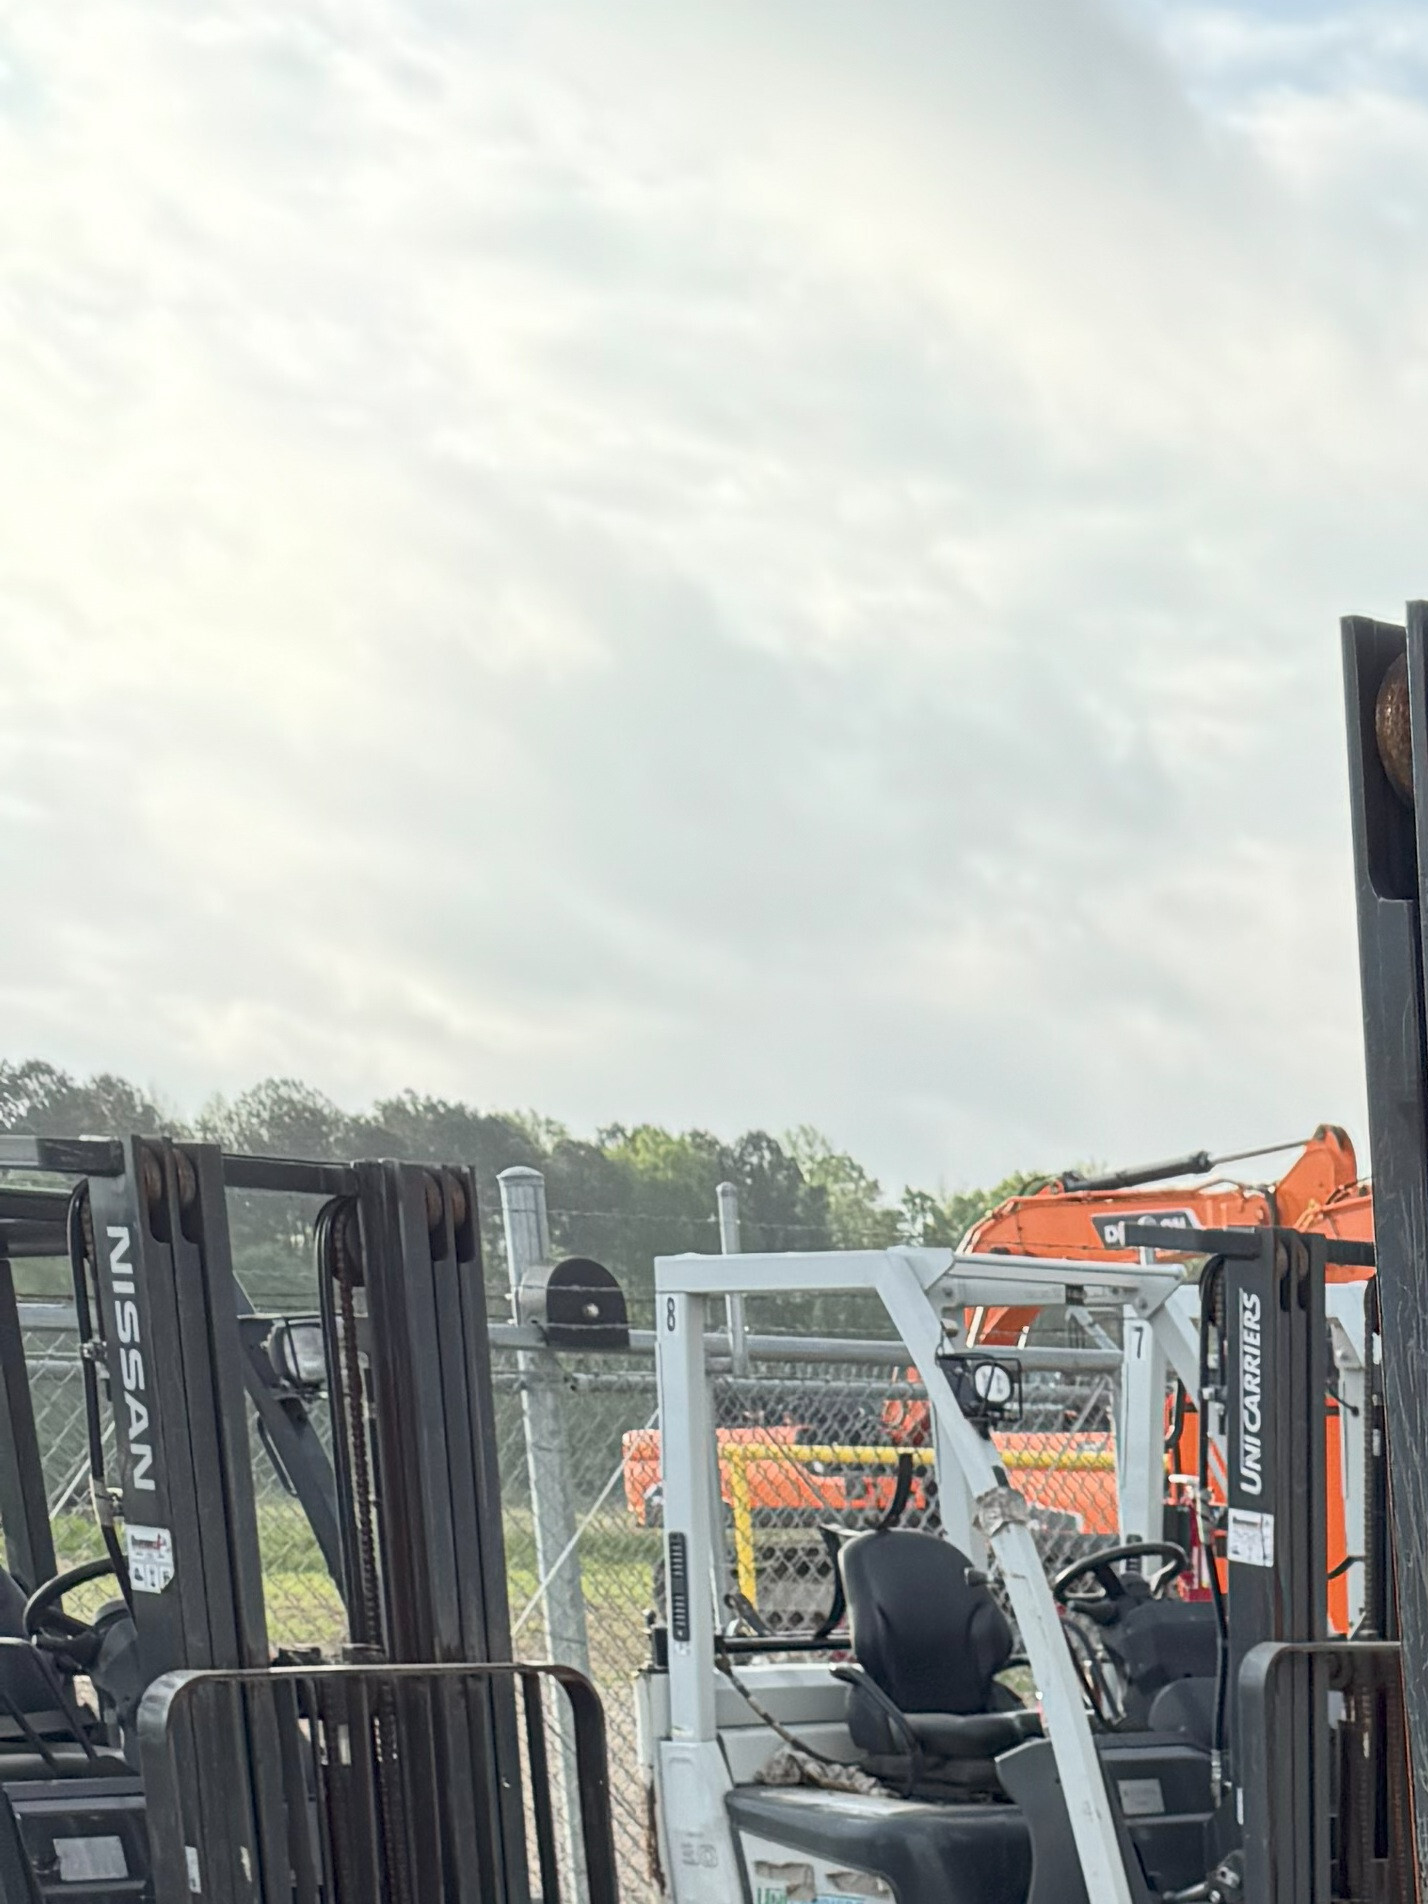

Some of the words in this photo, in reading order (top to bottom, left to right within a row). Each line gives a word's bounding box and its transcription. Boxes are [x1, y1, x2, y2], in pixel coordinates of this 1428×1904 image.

[666, 1297, 676, 1332] 8
[106, 1226, 156, 1491] NISSAN
[1132, 1326, 1144, 1359] 7
